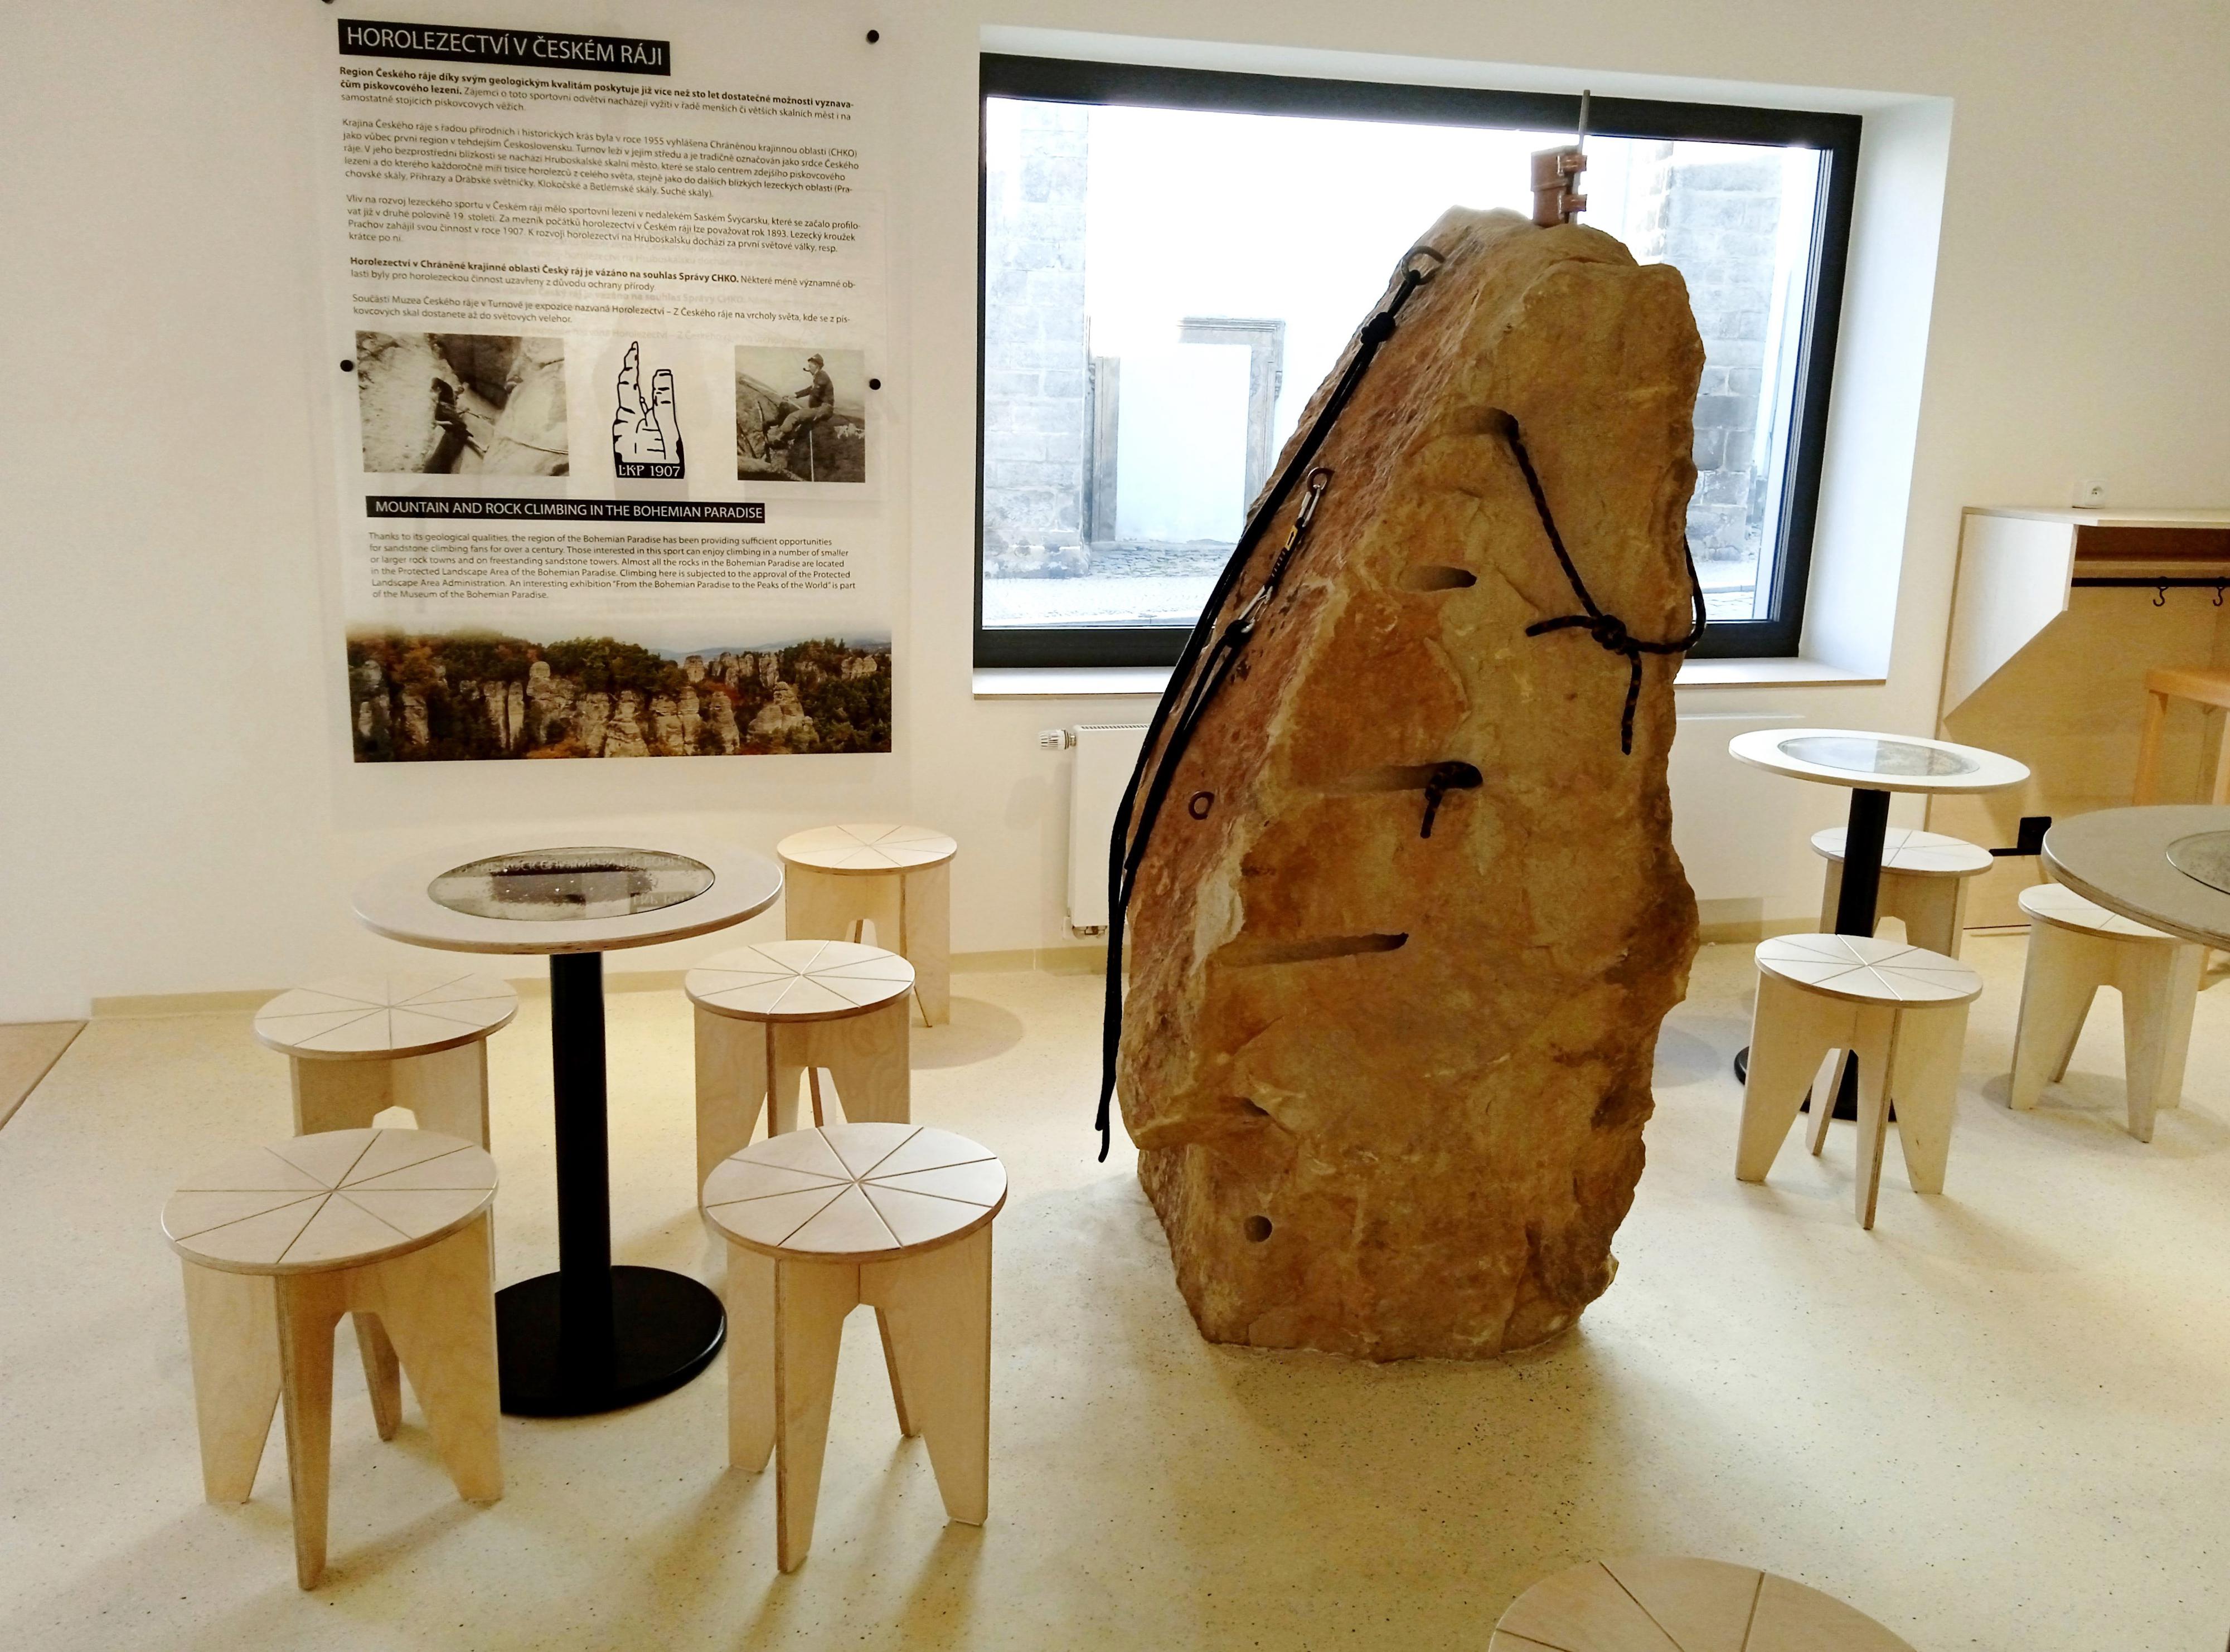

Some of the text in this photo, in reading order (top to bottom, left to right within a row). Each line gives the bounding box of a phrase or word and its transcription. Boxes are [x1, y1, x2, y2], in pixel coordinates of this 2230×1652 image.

[347, 27, 662, 66] HOROLEZECTVÍ V ČESKÉM RÁJI
[340, 66, 374, 77] Region
[375, 67, 416, 79] Českého
[418, 71, 437, 82] ráje
[438, 72, 459, 84] díky
[461, 74, 487, 83] svým
[488, 76, 550, 88] geologickým
[551, 80, 592, 90] kvalitám
[593, 83, 639, 95] poskytuje
[641, 85, 652, 96] již
[653, 86, 672, 95] více
[707, 90, 720, 99] let
[772, 95, 813, 105] možnosti
[815, 100, 854, 108] vyznava-
[342, 118, 374, 129] Krajina
[595, 133, 614, 143] byla
[644, 136, 665, 144] 1955
[827, 148, 857, 159] (CHKO)
[348, 219, 384, 228] Prachov
[633, 234, 691, 244] Hruboskalsku
[818, 245, 838, 254] resp.
[350, 256, 411, 267] Horolezectví
[467, 261, 506, 273] krajinné
[508, 264, 540, 273] oblasti
[542, 264, 569, 274] Český
[570, 266, 583, 277] ráj
[584, 267, 594, 278] je
[595, 268, 628, 277] vázáno
[642, 271, 677, 279] souhlas
[678, 272, 710, 283] Správy
[711, 274, 739, 283] CHKO.
[740, 275, 773, 284] Některé
[774, 276, 798, 285] méně
[798, 278, 841, 287] významné
[842, 280, 855, 288] ob-
[649, 465, 681, 477] 1907
[375, 501, 763, 518] MOUNTAIN AND ROCK CLIMBING IN THE BOHEMIAN PARADISE
[370, 532, 399, 540] Thanks
[413, 532, 424, 540] its
[424, 532, 470, 543] geological
[471, 533, 510, 543] qualities,
[527, 533, 555, 544] region
[583, 534, 626, 542] Bohemian
[662, 535, 677, 543] has
[678, 535, 699, 543] been
[700, 536, 740, 546] providing
[741, 536, 778, 545] sufficient
[778, 537, 832, 547] opportunities
[369, 543, 381, 551] for
[384, 543, 429, 552] sandstone
[430, 544, 468, 555] climbing
[469, 544, 488, 552] fans
[531, 546, 565, 556] century.
[568, 545, 592, 553] Those
[593, 546, 635, 554] interested
[662, 548, 685, 557] sport
[701, 547, 725, 557] enjoy
[726, 547, 762, 557] climbing
[762, 547, 770, 556] in
[821, 548, 849, 556] smaller
[381, 555, 406, 565] larger
[489, 556, 543, 566] freestanding
[544, 556, 588, 565] sandstone
[621, 557, 650, 565] Almost
[662, 557, 677, 566] the
[678, 557, 700, 566] rocks
[725, 558, 766, 566] Bohemian
[767, 558, 801, 567] Paradise
[815, 559, 845, 567] located
[372, 589, 381, 597] of
[382, 589, 398, 597] the
[466, 590, 510, 598] Bohemian
[511, 590, 549, 598] Paradise.
